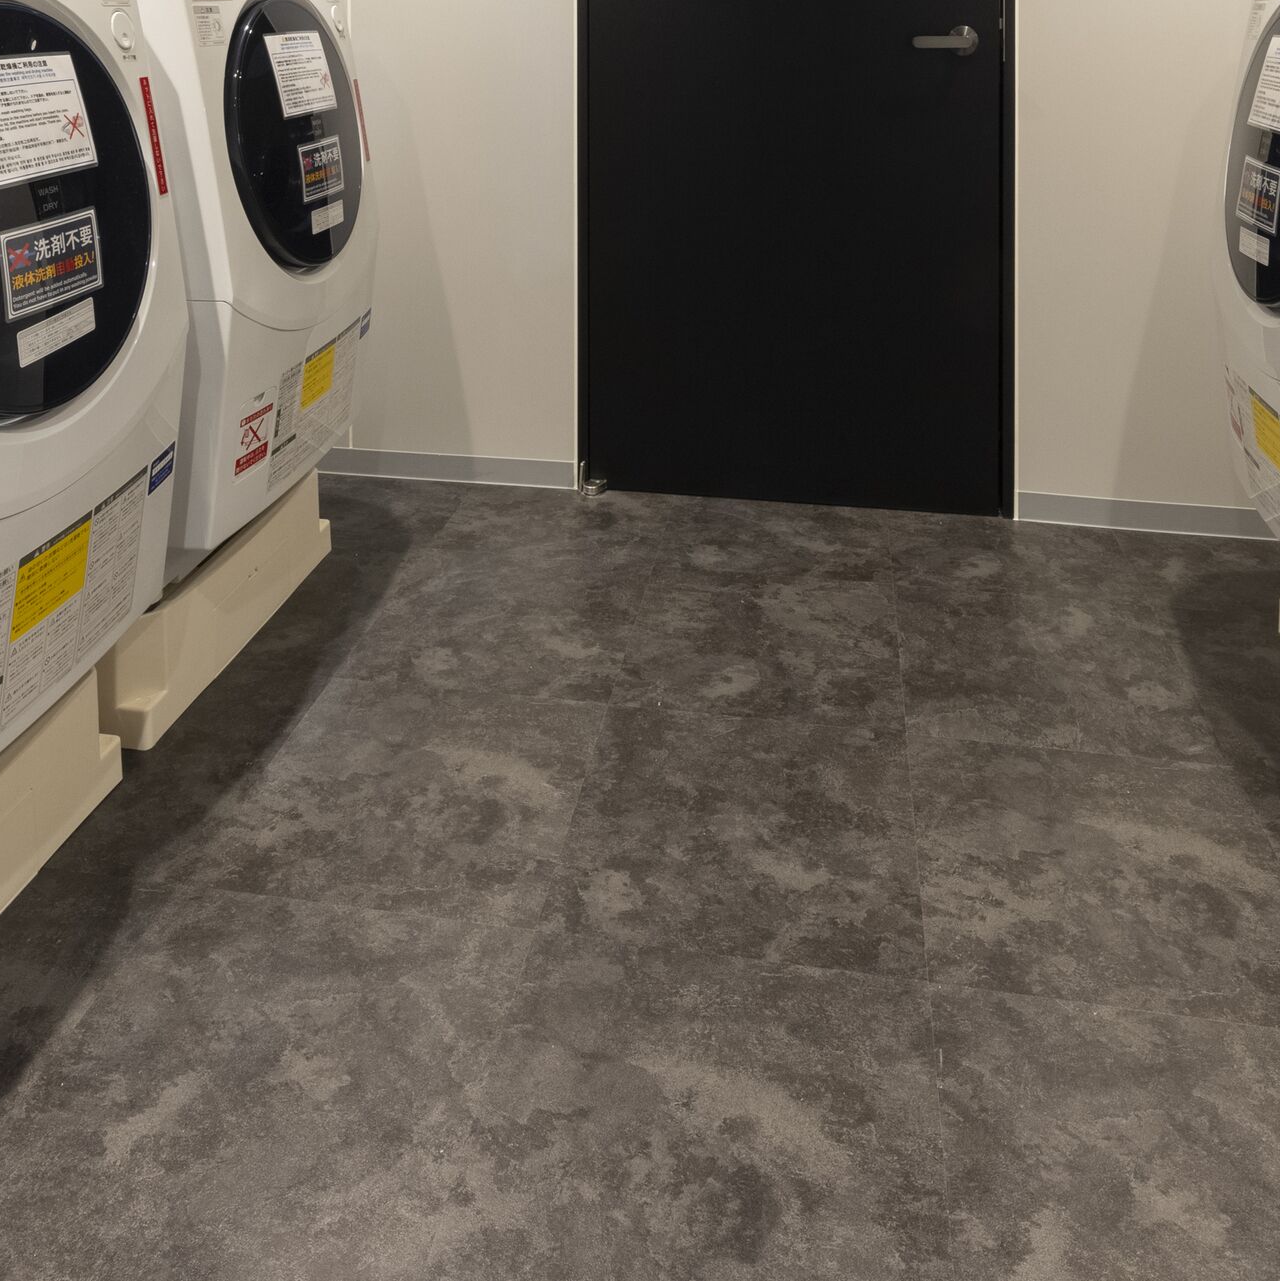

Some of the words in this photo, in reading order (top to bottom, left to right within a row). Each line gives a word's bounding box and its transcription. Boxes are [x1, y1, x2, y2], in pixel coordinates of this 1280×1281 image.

[37, 185, 59, 198] WASH
[42, 200, 59, 211] DRY
[33, 224, 93, 261] 洗剤不要
